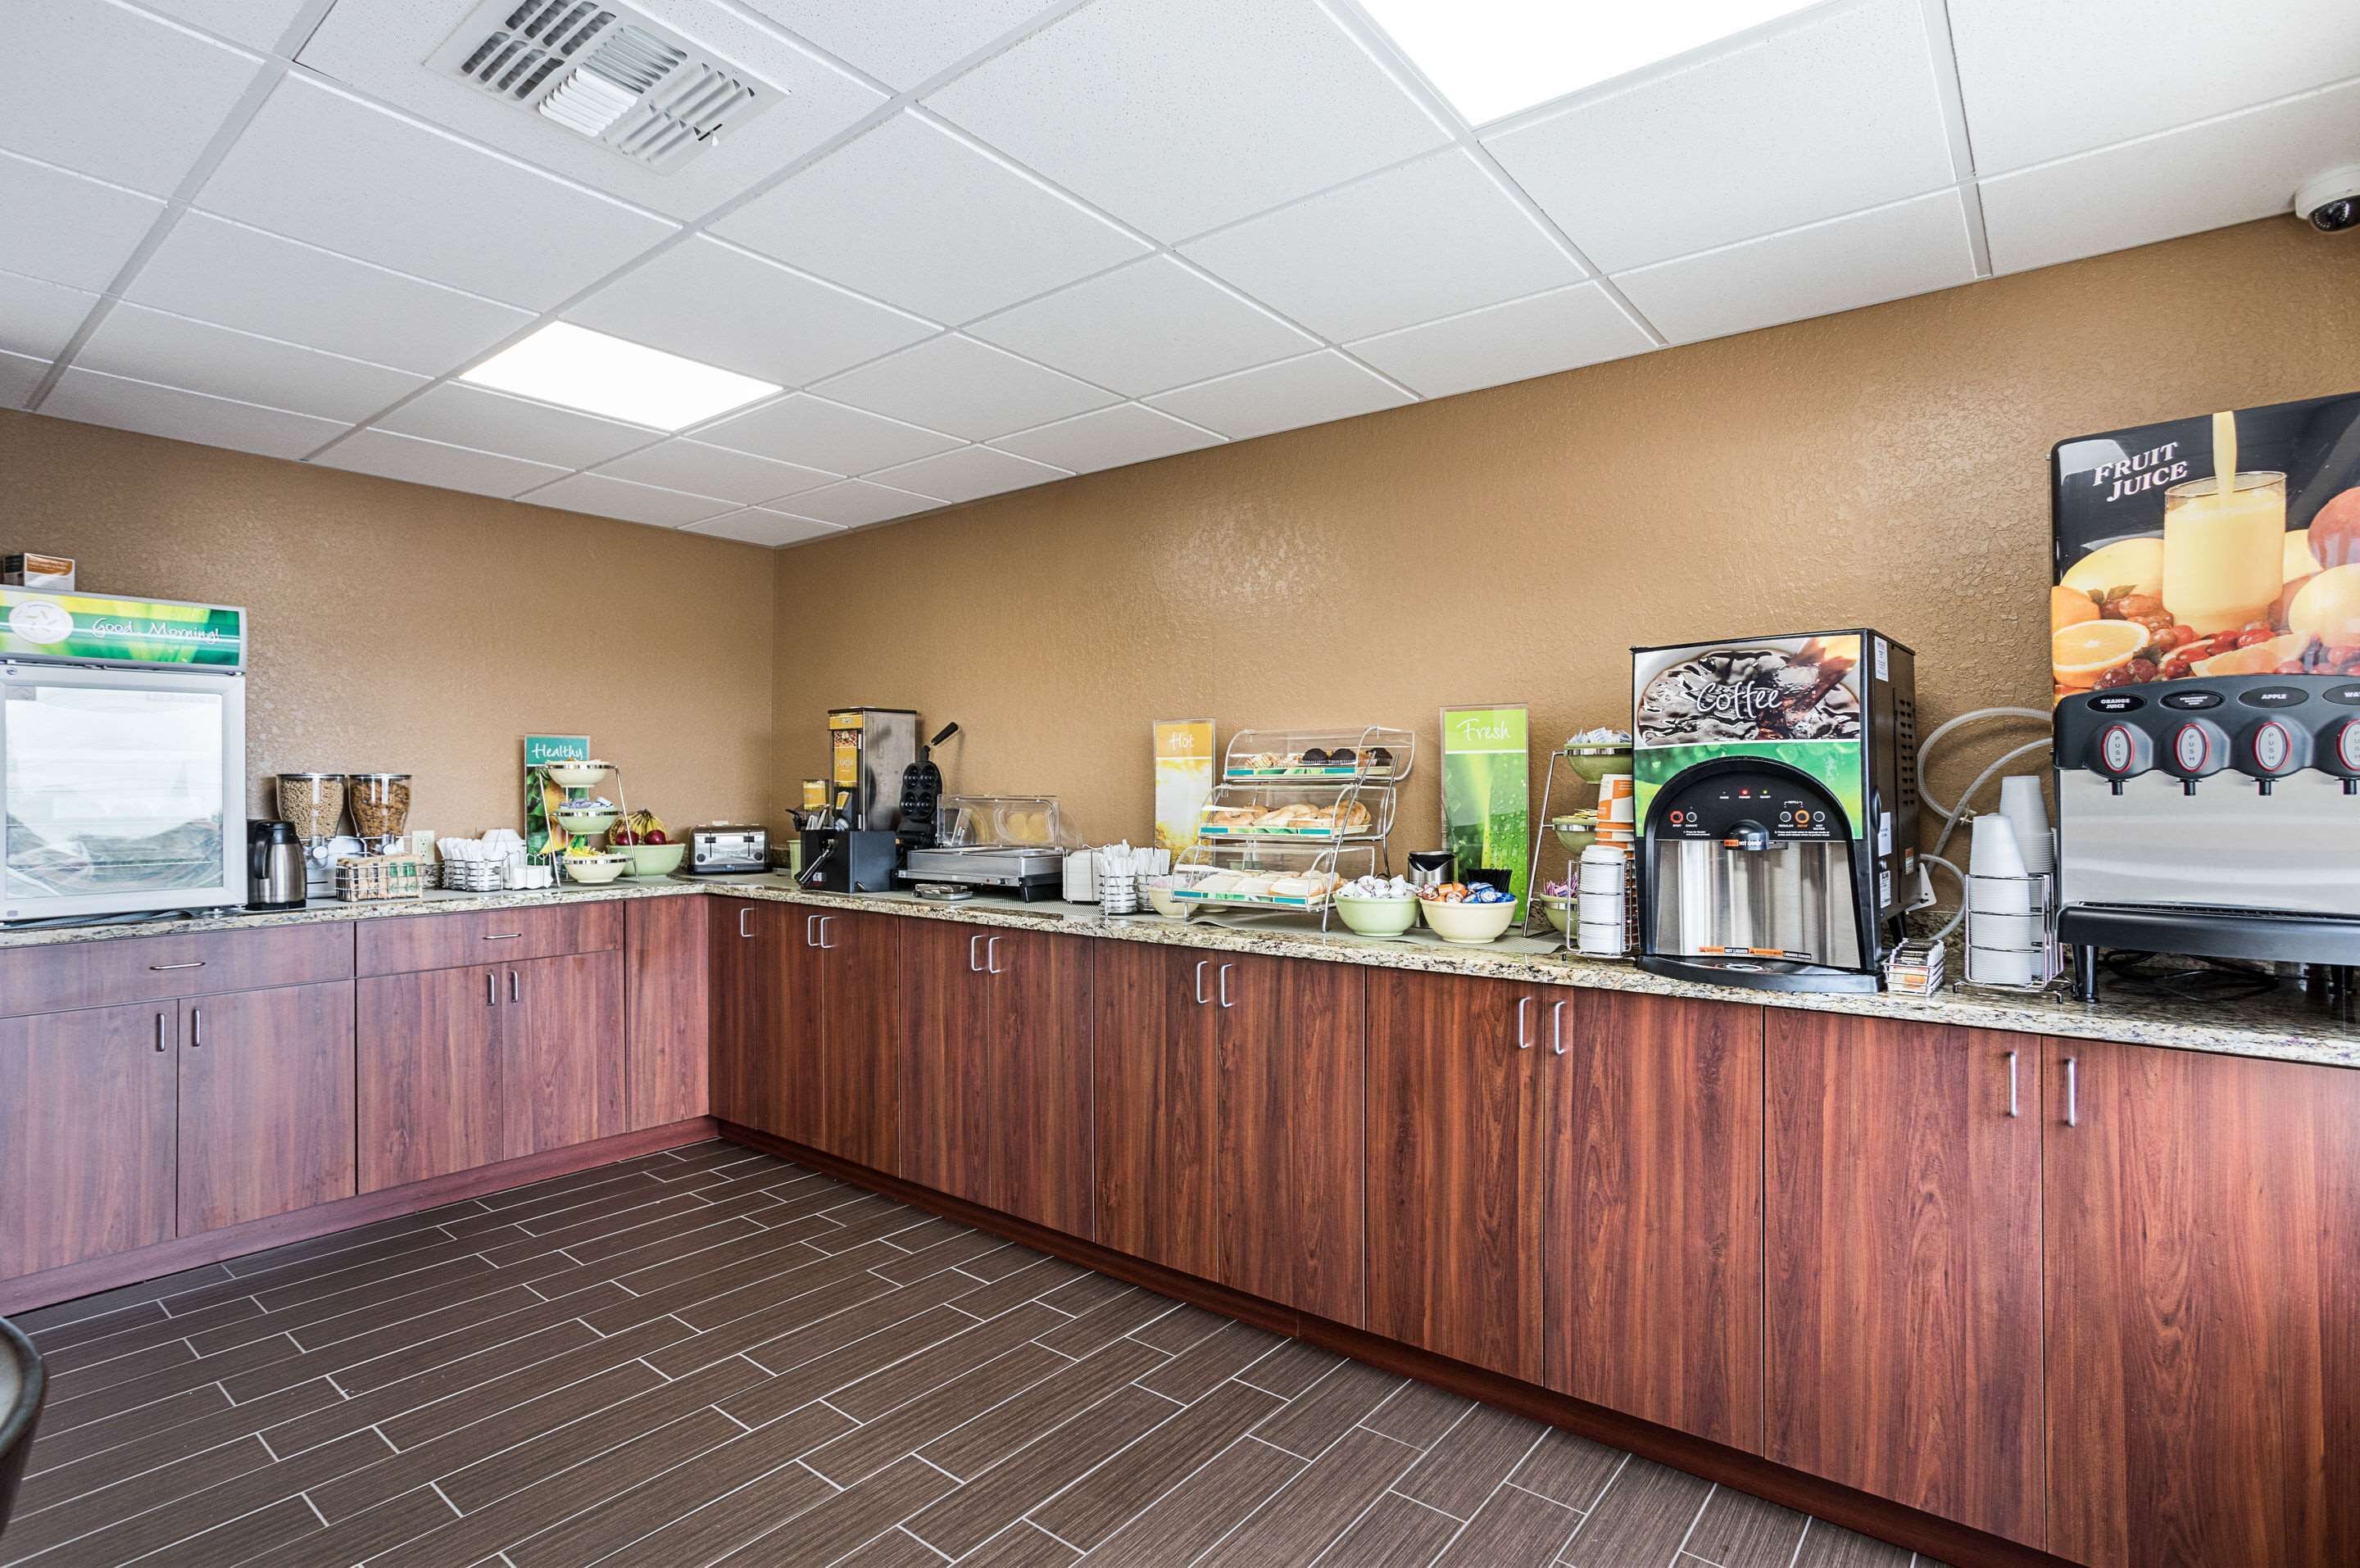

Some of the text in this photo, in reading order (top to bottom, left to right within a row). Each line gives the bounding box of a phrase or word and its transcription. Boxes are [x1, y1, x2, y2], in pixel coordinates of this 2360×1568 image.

[2092, 442, 2179, 487] FRUIT
[2106, 460, 2189, 502] JUICE
[92, 618, 220, 645] Good Morning!
[1696, 680, 1783, 719] Coffee
[1169, 731, 1195, 751] Hot
[1456, 718, 1511, 741] Fresh
[531, 742, 583, 761] Healthy
